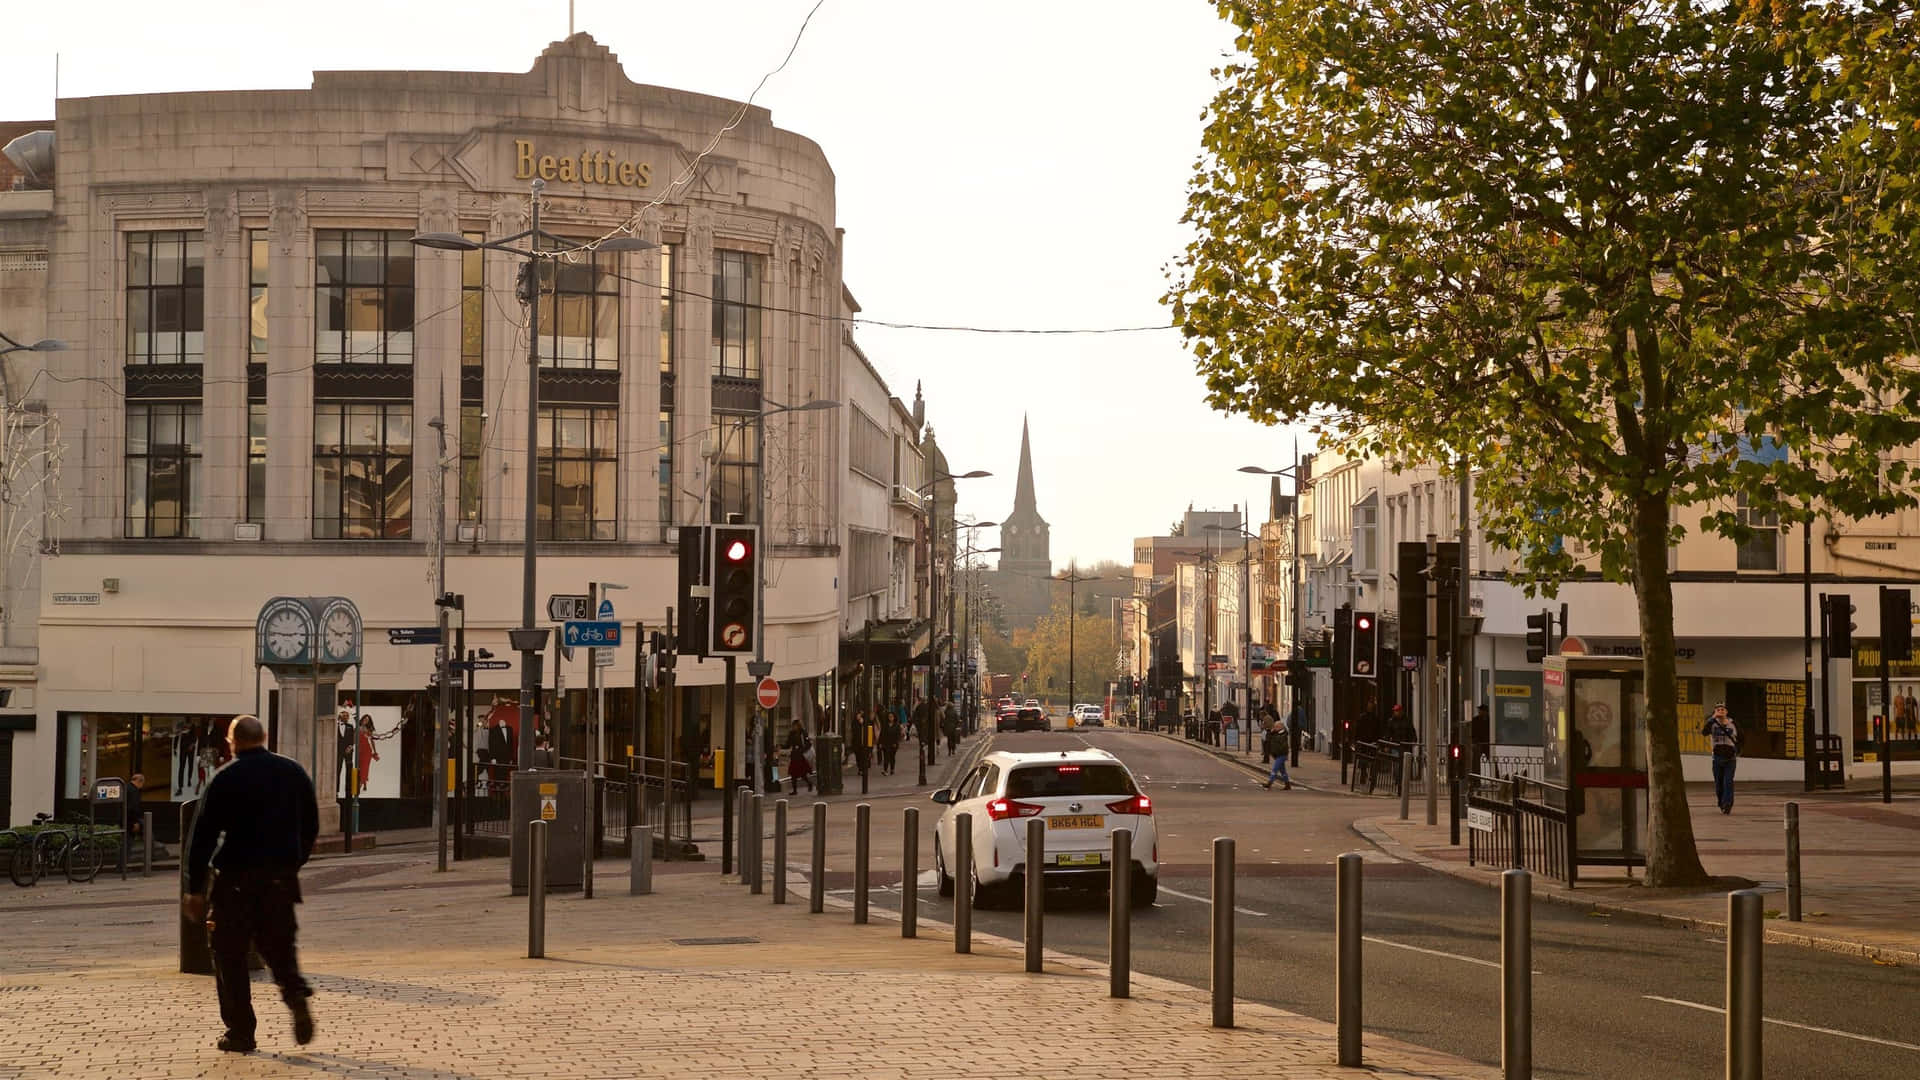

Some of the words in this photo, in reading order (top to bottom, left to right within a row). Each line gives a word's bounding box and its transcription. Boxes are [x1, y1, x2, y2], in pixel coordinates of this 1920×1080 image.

[514, 139, 653, 186] Beatties
[560, 600, 571, 617] WC
[1858, 650, 1880, 666] PROU
[1767, 682, 1796, 694] CHEQUE
[1767, 694, 1796, 704] CASHING
[1785, 705, 1796, 723] CASH
[1051, 817, 1077, 827] BK64
